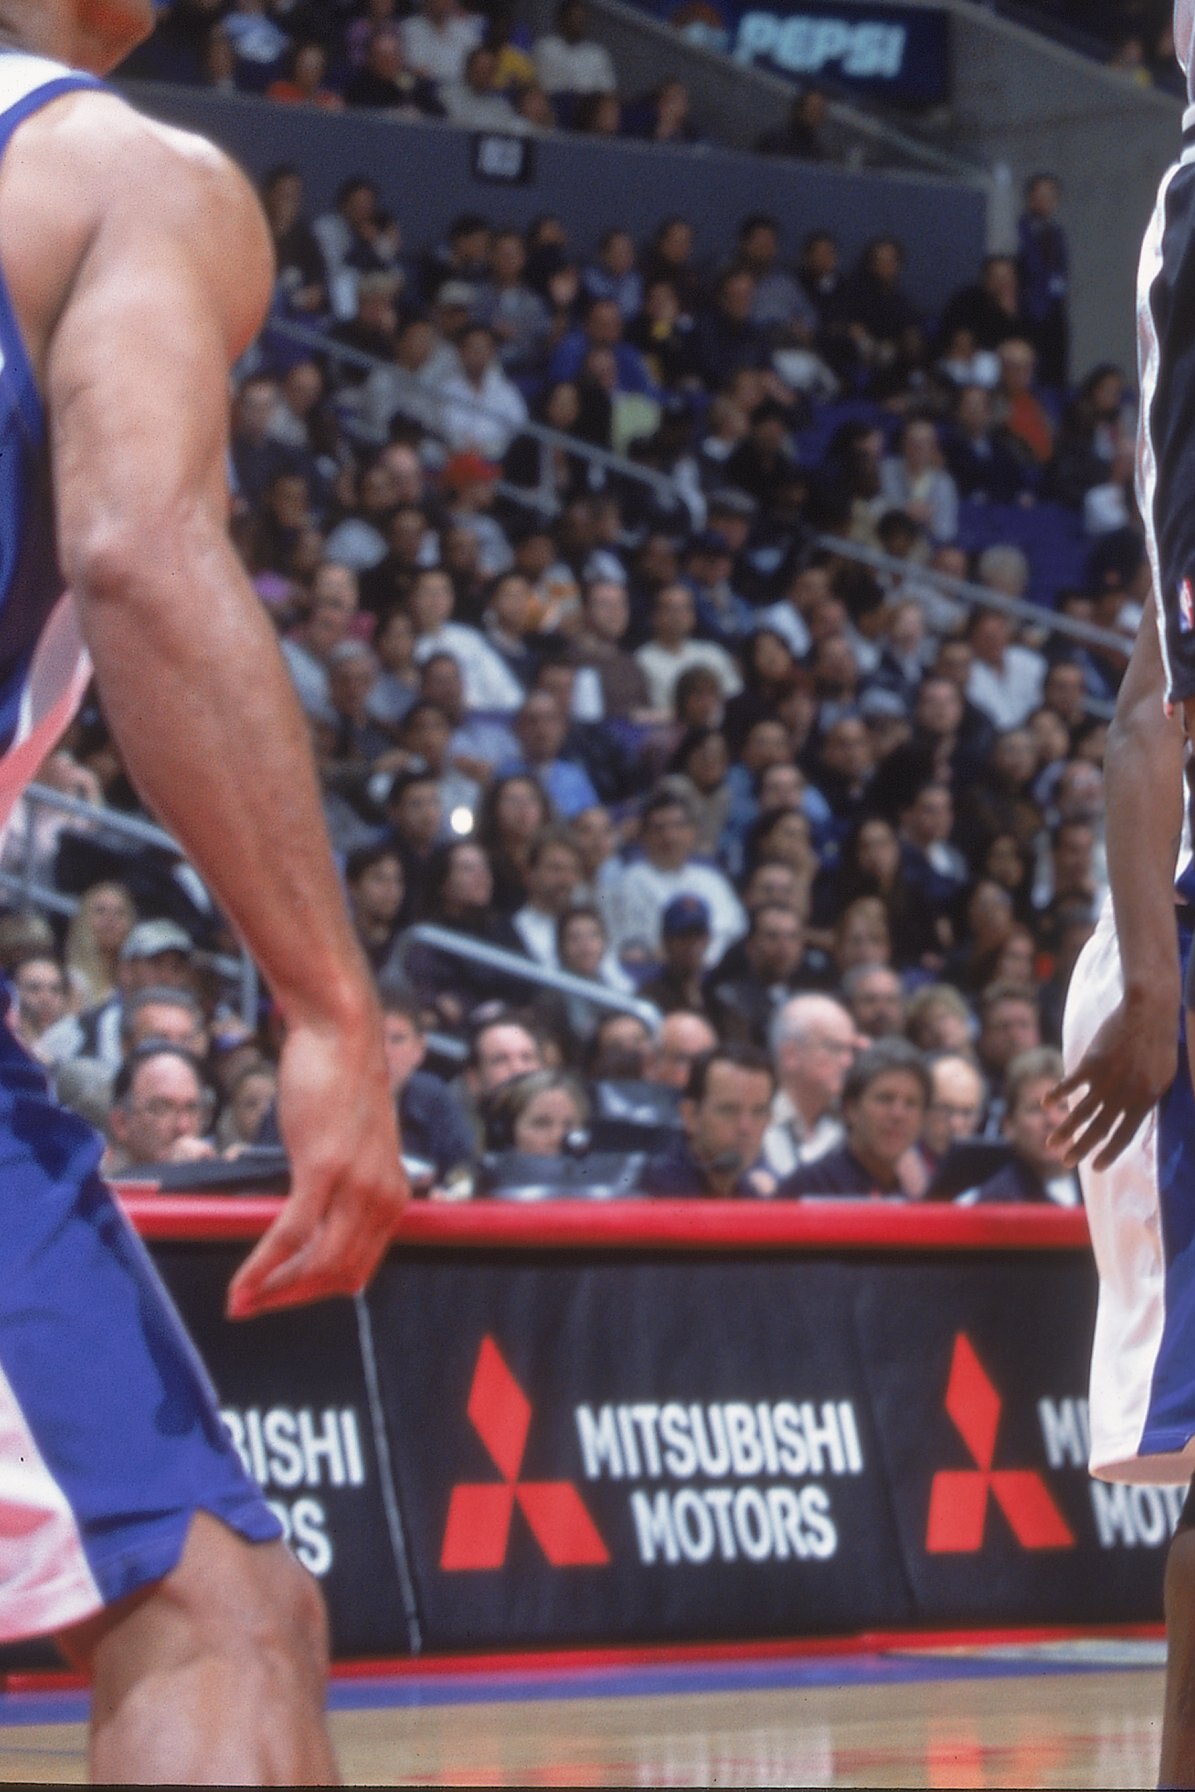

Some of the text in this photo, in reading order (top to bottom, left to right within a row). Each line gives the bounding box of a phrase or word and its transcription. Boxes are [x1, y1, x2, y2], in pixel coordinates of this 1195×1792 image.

[733, 11, 907, 79] PEPSI
[576, 1400, 865, 1479] MITSUBISHI
[631, 1486, 839, 1565] MOTORS
